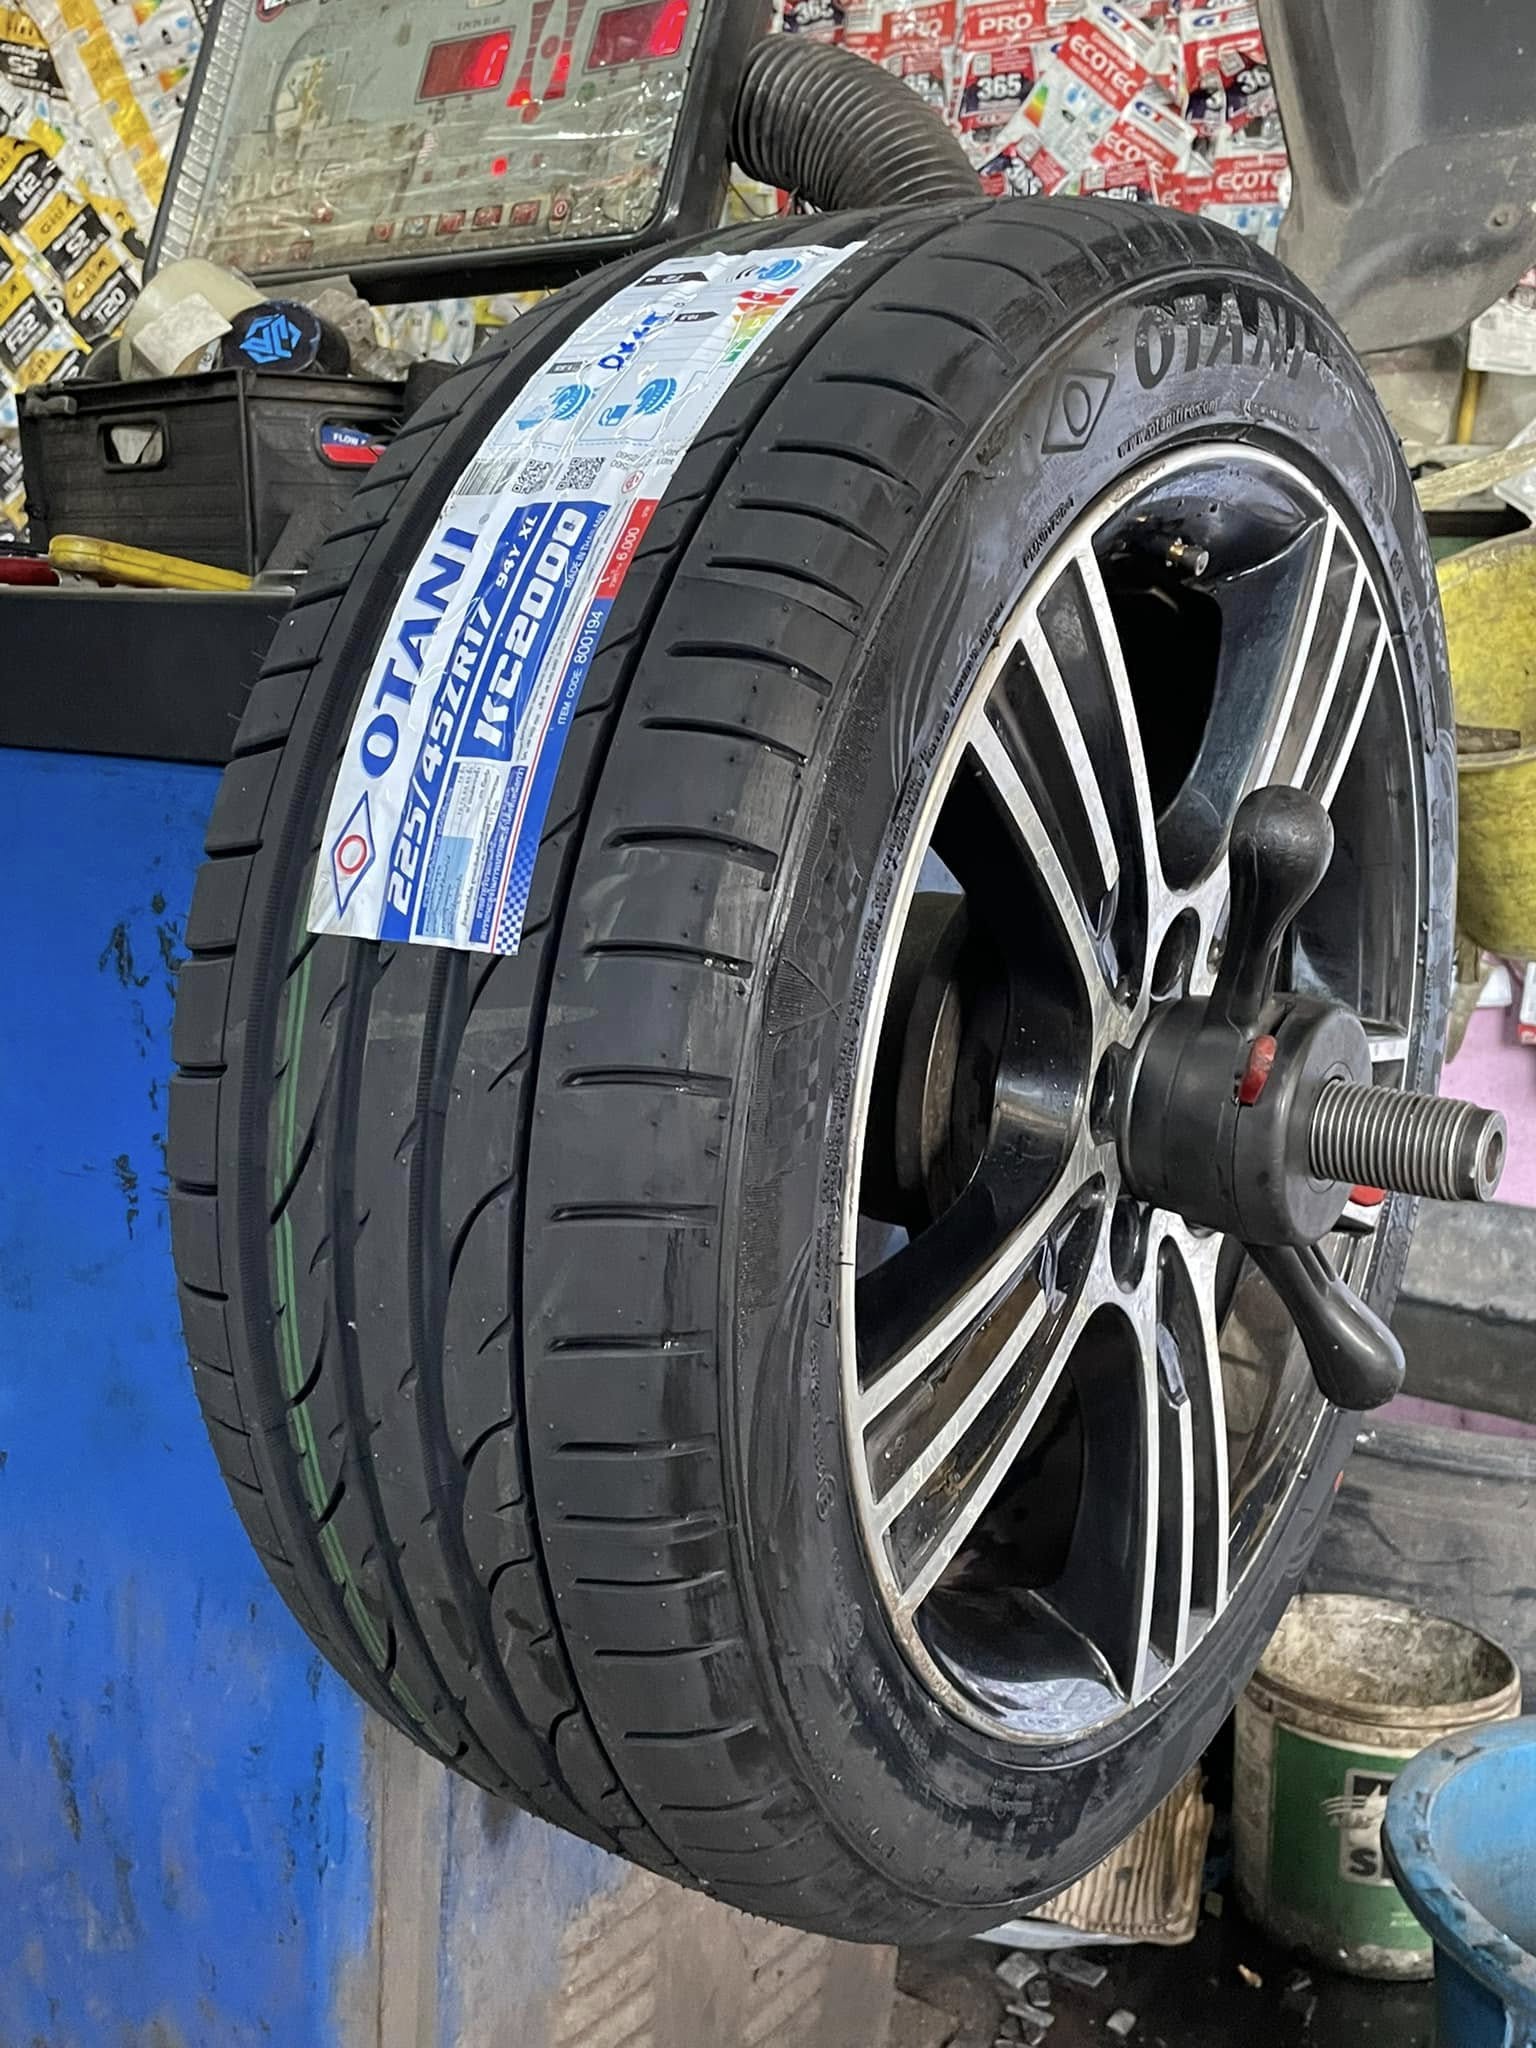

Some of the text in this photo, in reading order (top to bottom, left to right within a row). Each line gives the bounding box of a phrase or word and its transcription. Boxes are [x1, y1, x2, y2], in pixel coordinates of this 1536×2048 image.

[978, 13, 1034, 36] PRO
[977, 73, 1022, 99] 365
[1069, 34, 1138, 98] ECOTEC
[1237, 65, 1271, 94] 36
[92, 287, 127, 325] T20
[1134, 293, 1306, 390] OTANI
[565, 558, 583, 589] MADE
[582, 509, 607, 554] THAIAND
[360, 527, 479, 779] OTANI
[473, 507, 588, 748] KC2000
[557, 703, 572, 726] ITEM
[573, 610, 605, 665] 800194
[387, 597, 492, 916] 225/45ZR17
[495, 540, 522, 590] 94Y
[518, 514, 539, 541] XL
